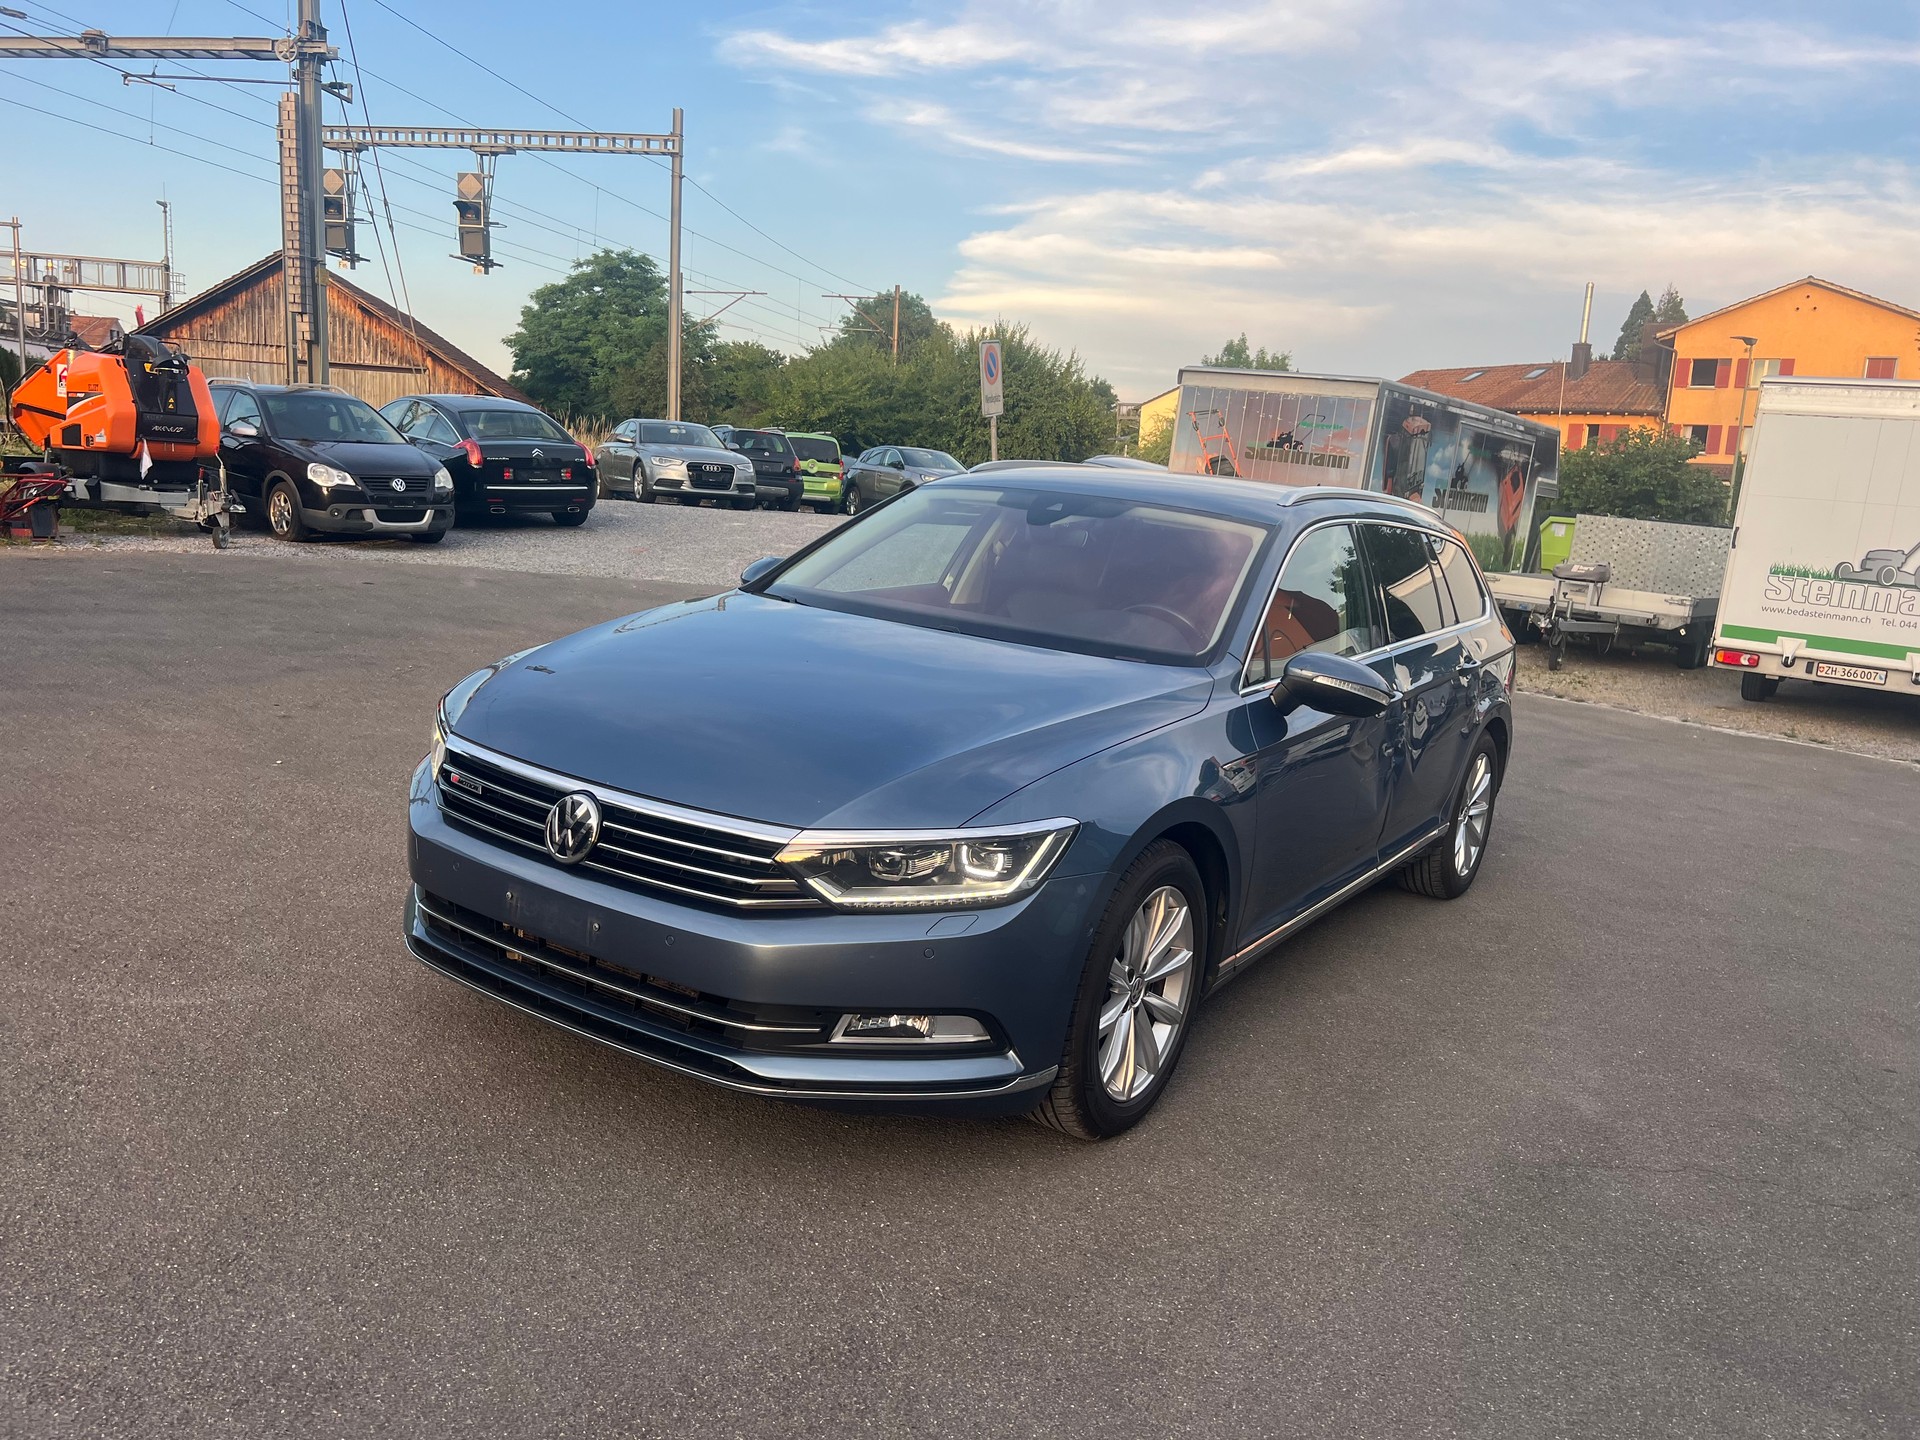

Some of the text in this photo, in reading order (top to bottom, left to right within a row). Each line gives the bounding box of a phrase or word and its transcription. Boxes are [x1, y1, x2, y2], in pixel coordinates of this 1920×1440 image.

[1761, 604, 1918, 629] www.bedasteinmann.ch Tel. 044
